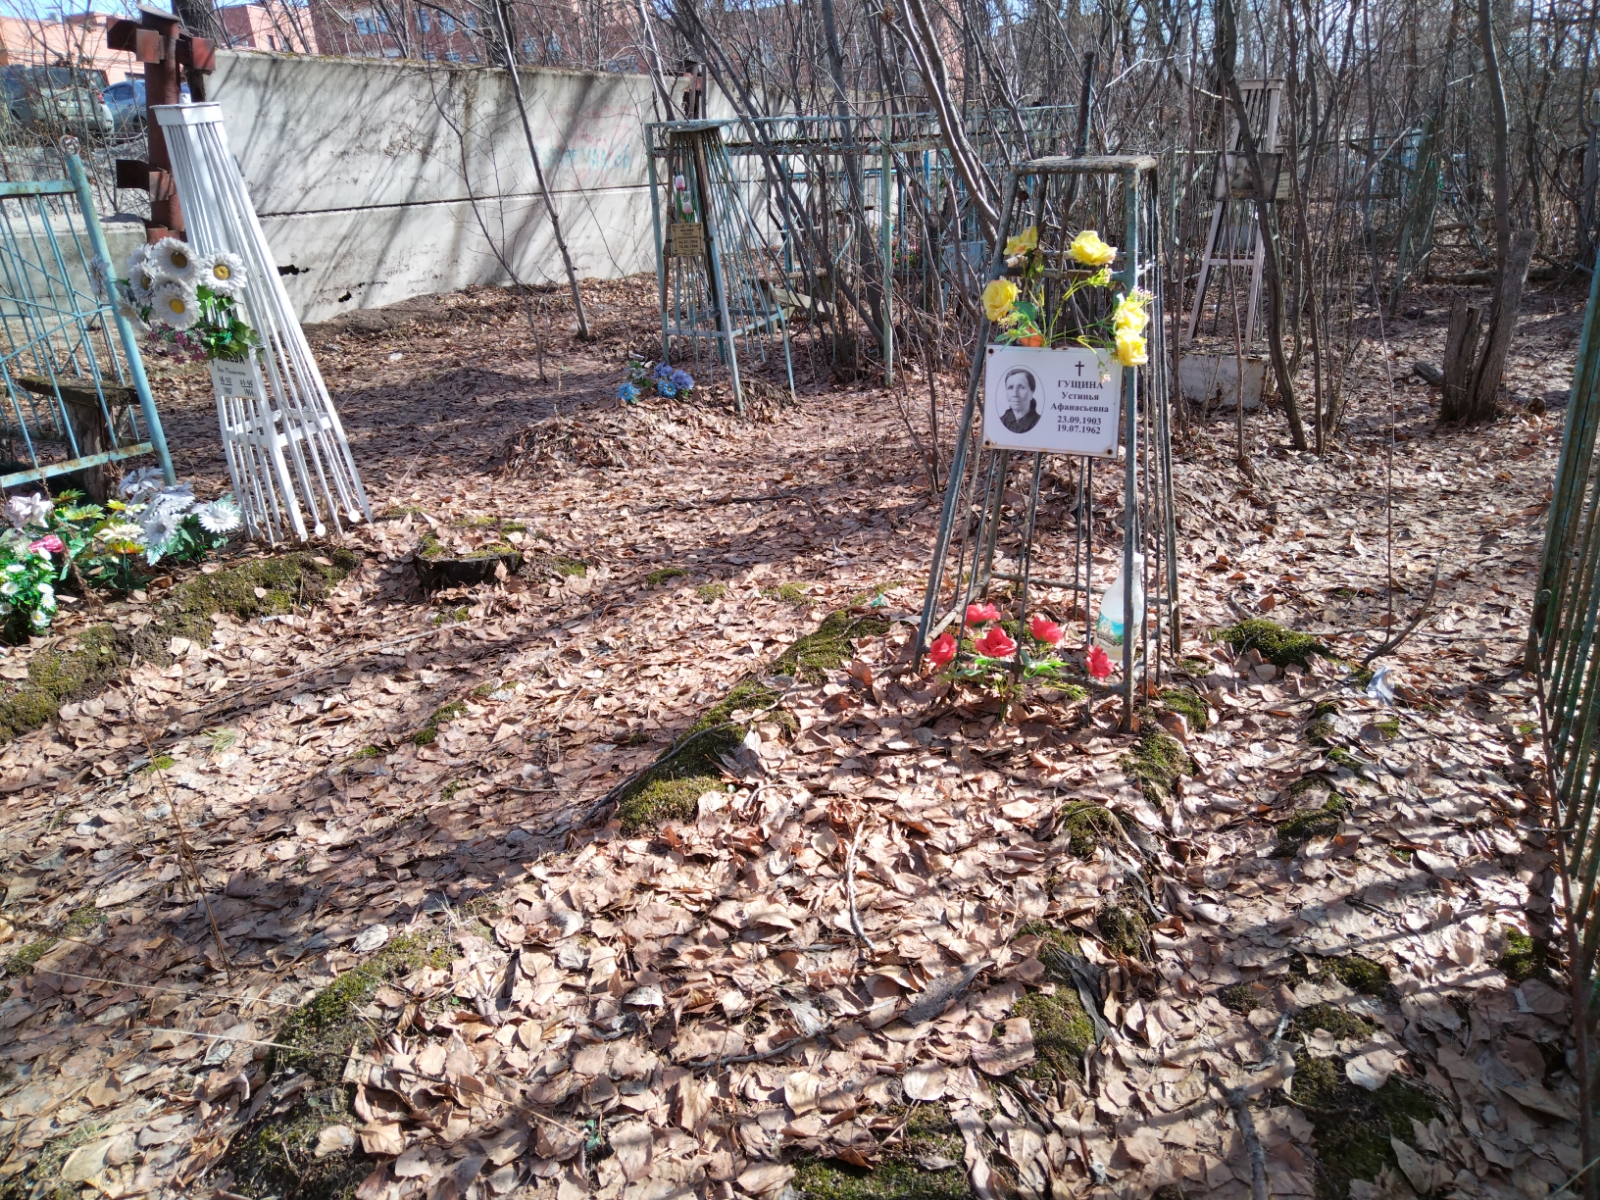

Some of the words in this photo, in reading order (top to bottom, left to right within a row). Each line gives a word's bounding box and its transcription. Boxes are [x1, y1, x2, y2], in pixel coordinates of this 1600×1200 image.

[1057, 380, 1103, 389] ГУЩИНА
[1061, 391, 1099, 401] Устинья
[1050, 402, 1109, 412] Афанасьевна
[1057, 415, 1101, 425] 23.09.1903
[1057, 424, 1101, 434] 19.07.1962
